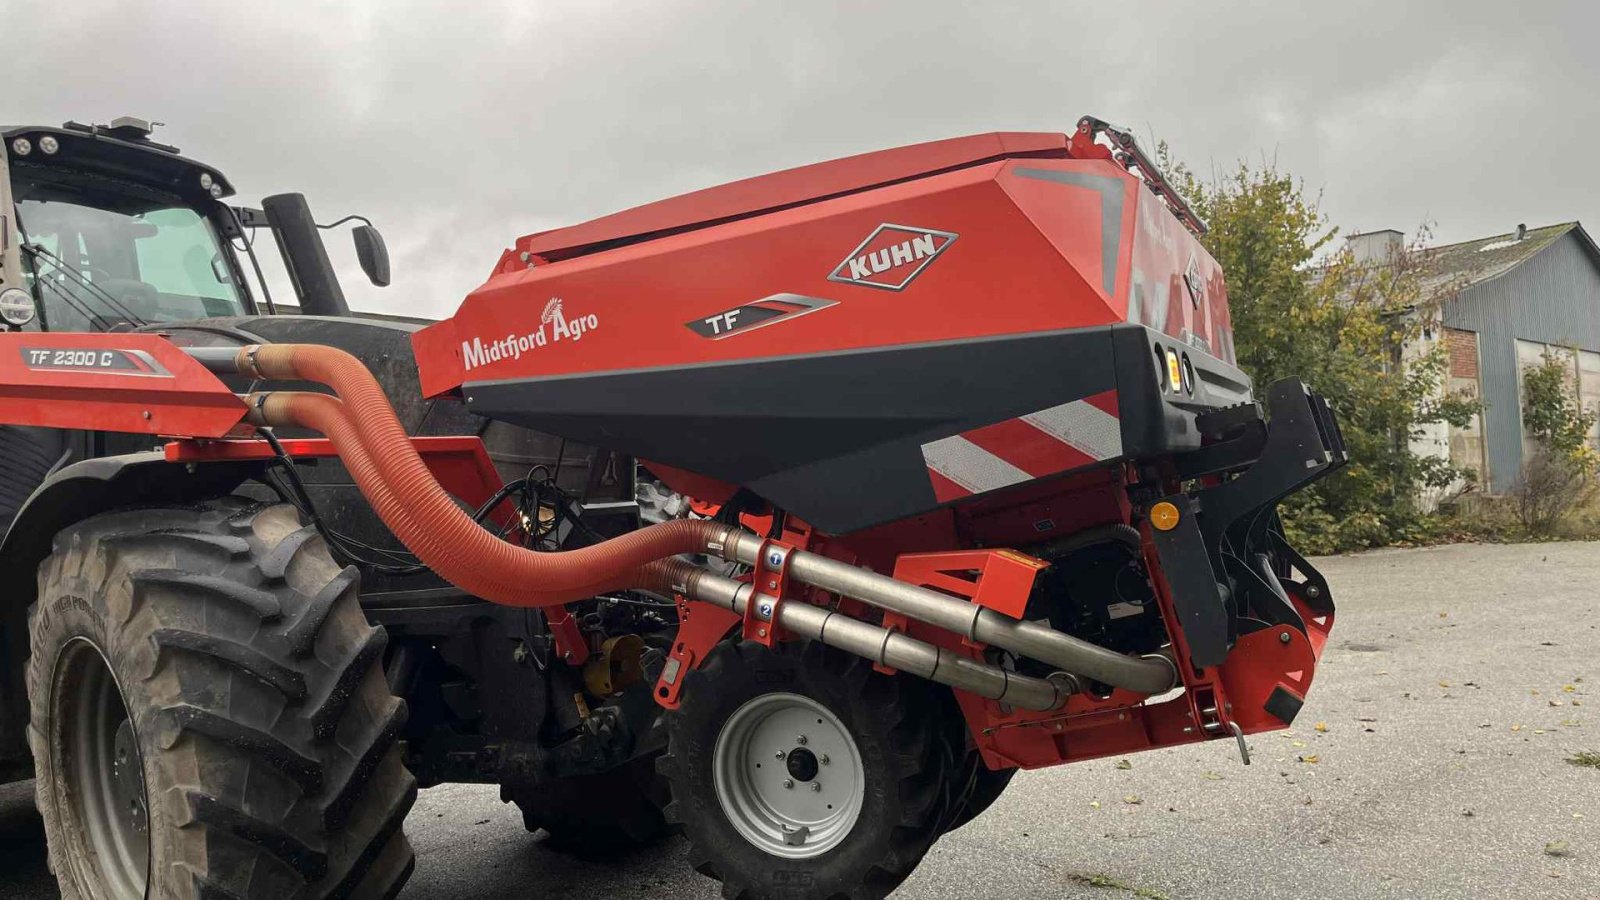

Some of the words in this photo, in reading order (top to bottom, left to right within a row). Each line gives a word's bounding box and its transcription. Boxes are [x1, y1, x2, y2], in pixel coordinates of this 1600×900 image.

[849, 233, 937, 280] KUHN
[705, 309, 742, 335] TF
[462, 325, 547, 371] Midtfjord
[553, 309, 598, 341] Agro
[30, 350, 50, 365] TF
[53, 351, 95, 366] 2300
[100, 352, 113, 367] C
[763, 605, 770, 615] 2
